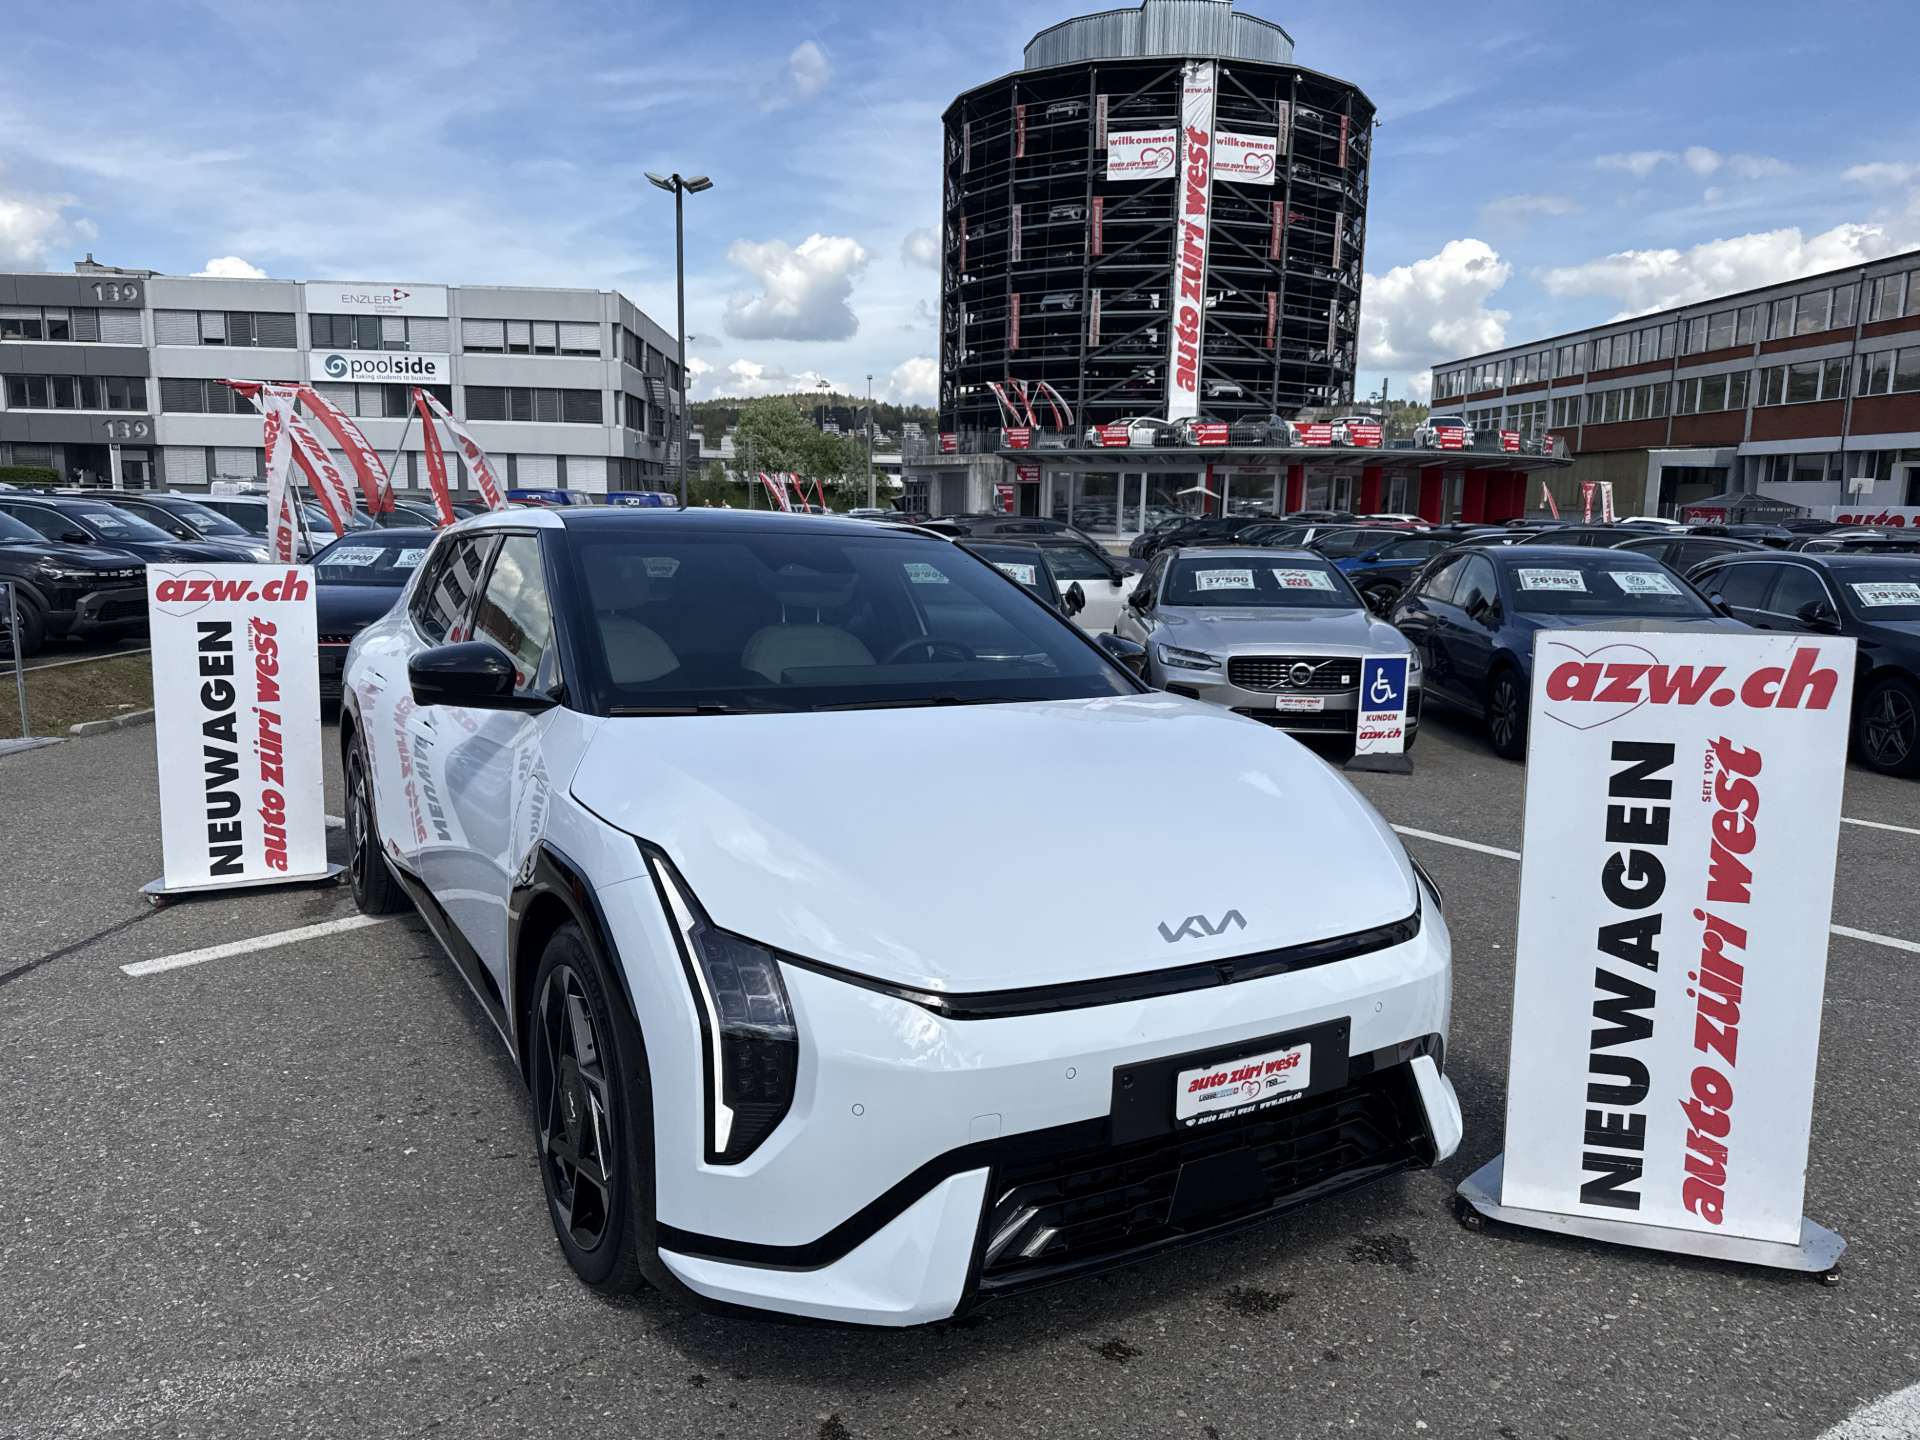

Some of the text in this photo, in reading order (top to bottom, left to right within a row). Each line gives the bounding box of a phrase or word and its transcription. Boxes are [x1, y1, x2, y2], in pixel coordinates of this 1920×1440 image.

[1109, 136, 1174, 146] willkommen
[1216, 136, 1275, 150] willkommen
[1176, 125, 1209, 392] auto züri west
[92, 282, 138, 301] 139
[342, 294, 392, 304] ENZLER
[350, 356, 436, 378] poolside
[103, 420, 149, 438] 139
[156, 570, 309, 602] azw.ch
[1530, 576, 1578, 584] 26'850
[1546, 648, 1838, 710] azw.ch
[1366, 714, 1398, 722] KUNDEN
[252, 616, 288, 872] auto züri west
[1359, 728, 1402, 740] azw.ch
[196, 621, 244, 876] NEUWAGEN
[1702, 749, 1714, 802] SEIT 1991
[1158, 909, 1248, 943] KIA
[1580, 740, 1676, 1210] NEUWAGEN
[1678, 736, 1762, 1225] auto züri west
[1188, 1054, 1300, 1092] auto züri west
[1198, 1114, 1217, 1124] auto
[1218, 1110, 1236, 1120] züri
[1238, 1105, 1255, 1115] west
